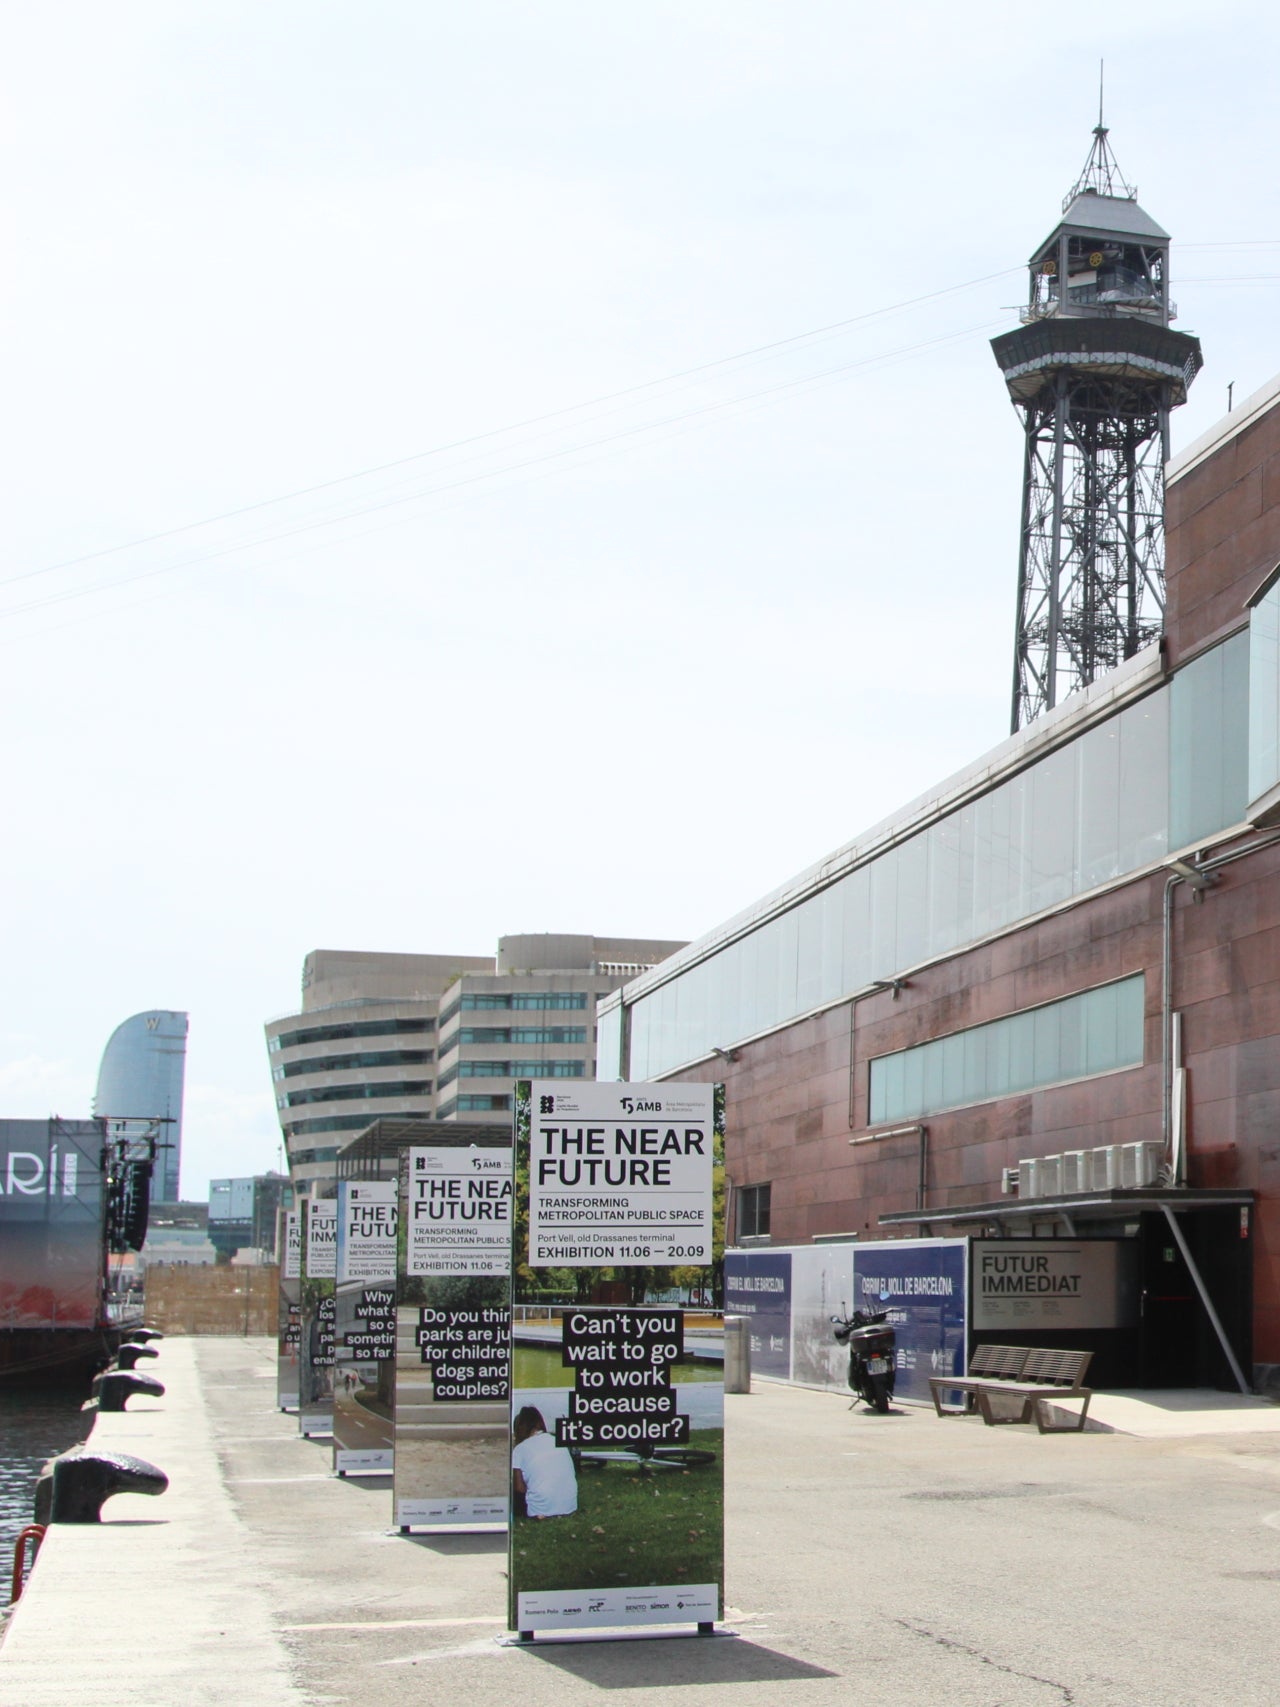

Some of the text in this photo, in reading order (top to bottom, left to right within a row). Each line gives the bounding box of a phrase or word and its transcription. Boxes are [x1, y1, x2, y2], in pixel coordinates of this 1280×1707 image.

[144, 1016, 160, 1031] W
[636, 1102, 662, 1112] AMB
[539, 1128, 705, 1155] THE NEAR
[538, 1159, 671, 1186] FUTURE
[415, 1180, 461, 1198] THE
[414, 1201, 507, 1220] FUTURE
[539, 1198, 629, 1208] TRANSFORMING
[350, 1206, 385, 1221] THE
[538, 1210, 704, 1220] METROPOLITAN PUBLIC SPACE
[538, 1233, 675, 1244] Port Vell, old Drassanes terminal
[538, 1247, 614, 1258] EXHIBITION
[619, 1246, 650, 1257] 11.06
[667, 1246, 704, 1257] 20.09
[413, 1261, 467, 1270] EXHIBITION
[471, 1261, 493, 1270] 11.06
[982, 1256, 1049, 1273] FUTUR
[727, 1276, 738, 1291] OBRIM
[744, 1276, 754, 1292] MOLL
[760, 1276, 785, 1292] BARCELONA
[862, 1277, 880, 1295] OBRIM
[888, 1277, 904, 1295] MOLL
[904, 1277, 913, 1295] DE
[913, 1276, 953, 1296] BARCELONA
[982, 1275, 1081, 1293] IMMEDIAT
[365, 1291, 393, 1305] Why
[319, 1310, 334, 1319] los
[357, 1305, 389, 1316] what
[424, 1308, 446, 1323] Do
[450, 1312, 478, 1326] you
[370, 1321, 384, 1330] so
[635, 1317, 676, 1339] you
[420, 1327, 463, 1345] parks
[467, 1330, 493, 1341] are
[356, 1347, 391, 1358] so far
[425, 1345, 448, 1359] for
[568, 1340, 678, 1365] wait to go
[436, 1363, 508, 1381] dogs and
[580, 1366, 665, 1387] to work
[436, 1381, 508, 1399] couples?
[575, 1394, 671, 1414] because
[600, 1418, 684, 1440] cooler?
